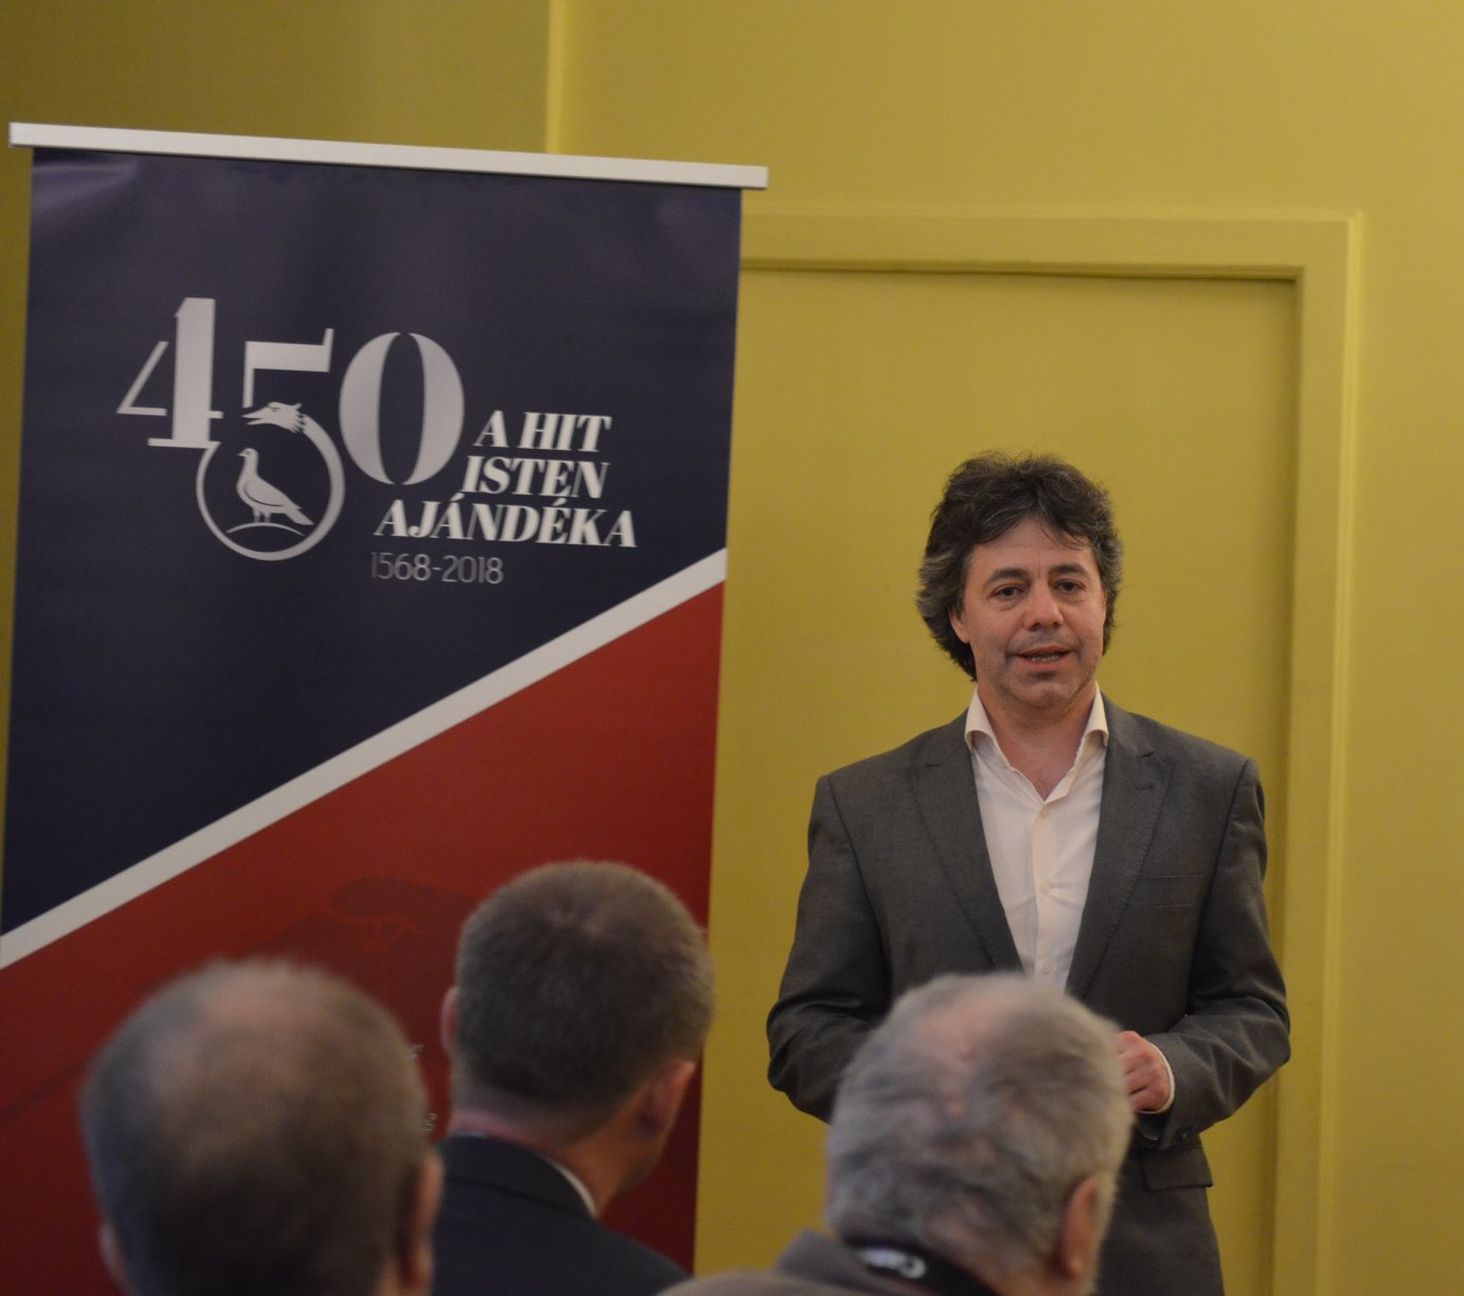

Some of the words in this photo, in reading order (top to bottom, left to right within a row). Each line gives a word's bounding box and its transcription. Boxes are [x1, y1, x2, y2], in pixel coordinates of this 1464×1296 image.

[117, 297, 465, 561] 450
[473, 410, 509, 448] A
[517, 411, 613, 453] HIT
[460, 455, 612, 499] ISTEN
[373, 492, 638, 548] AJÁNDÉKA
[370, 551, 504, 585] 1568-2018
